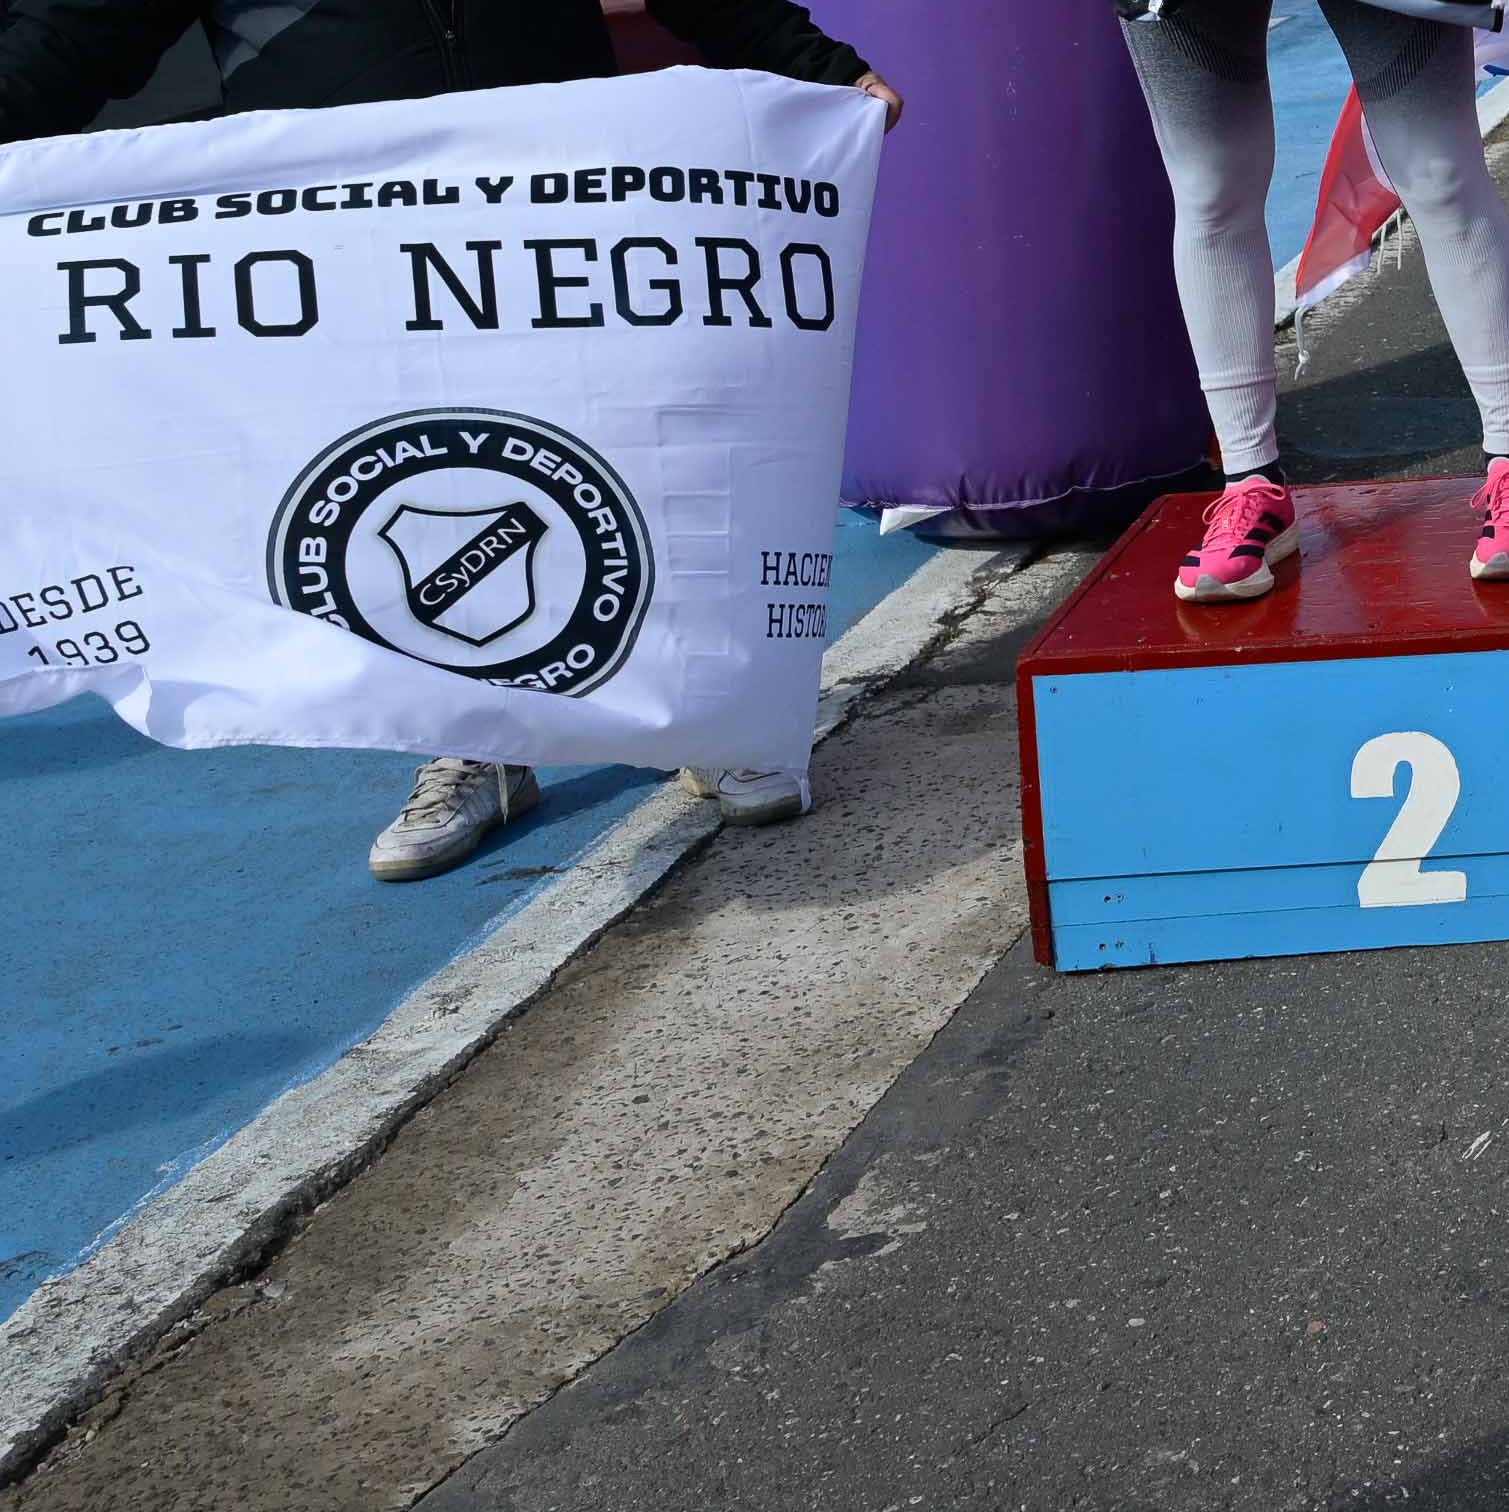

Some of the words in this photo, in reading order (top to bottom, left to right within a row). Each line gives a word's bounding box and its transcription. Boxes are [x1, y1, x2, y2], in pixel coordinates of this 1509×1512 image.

[28, 199, 198, 236] CLUB
[216, 179, 459, 219] SOCIAL
[476, 176, 513, 203] Y
[531, 167, 839, 218] DEPORTIVO
[58, 250, 318, 345] RIO
[400, 237, 834, 331] NEGRO
[310, 434, 449, 528] SOCIAL
[459, 431, 490, 455] Y
[502, 437, 629, 622] DEPORTIVO
[418, 517, 528, 607] CSyDRN
[28, 620, 151, 666] 1939
[481, 643, 597, 689] GRO
[1351, 732, 1467, 908] 2
